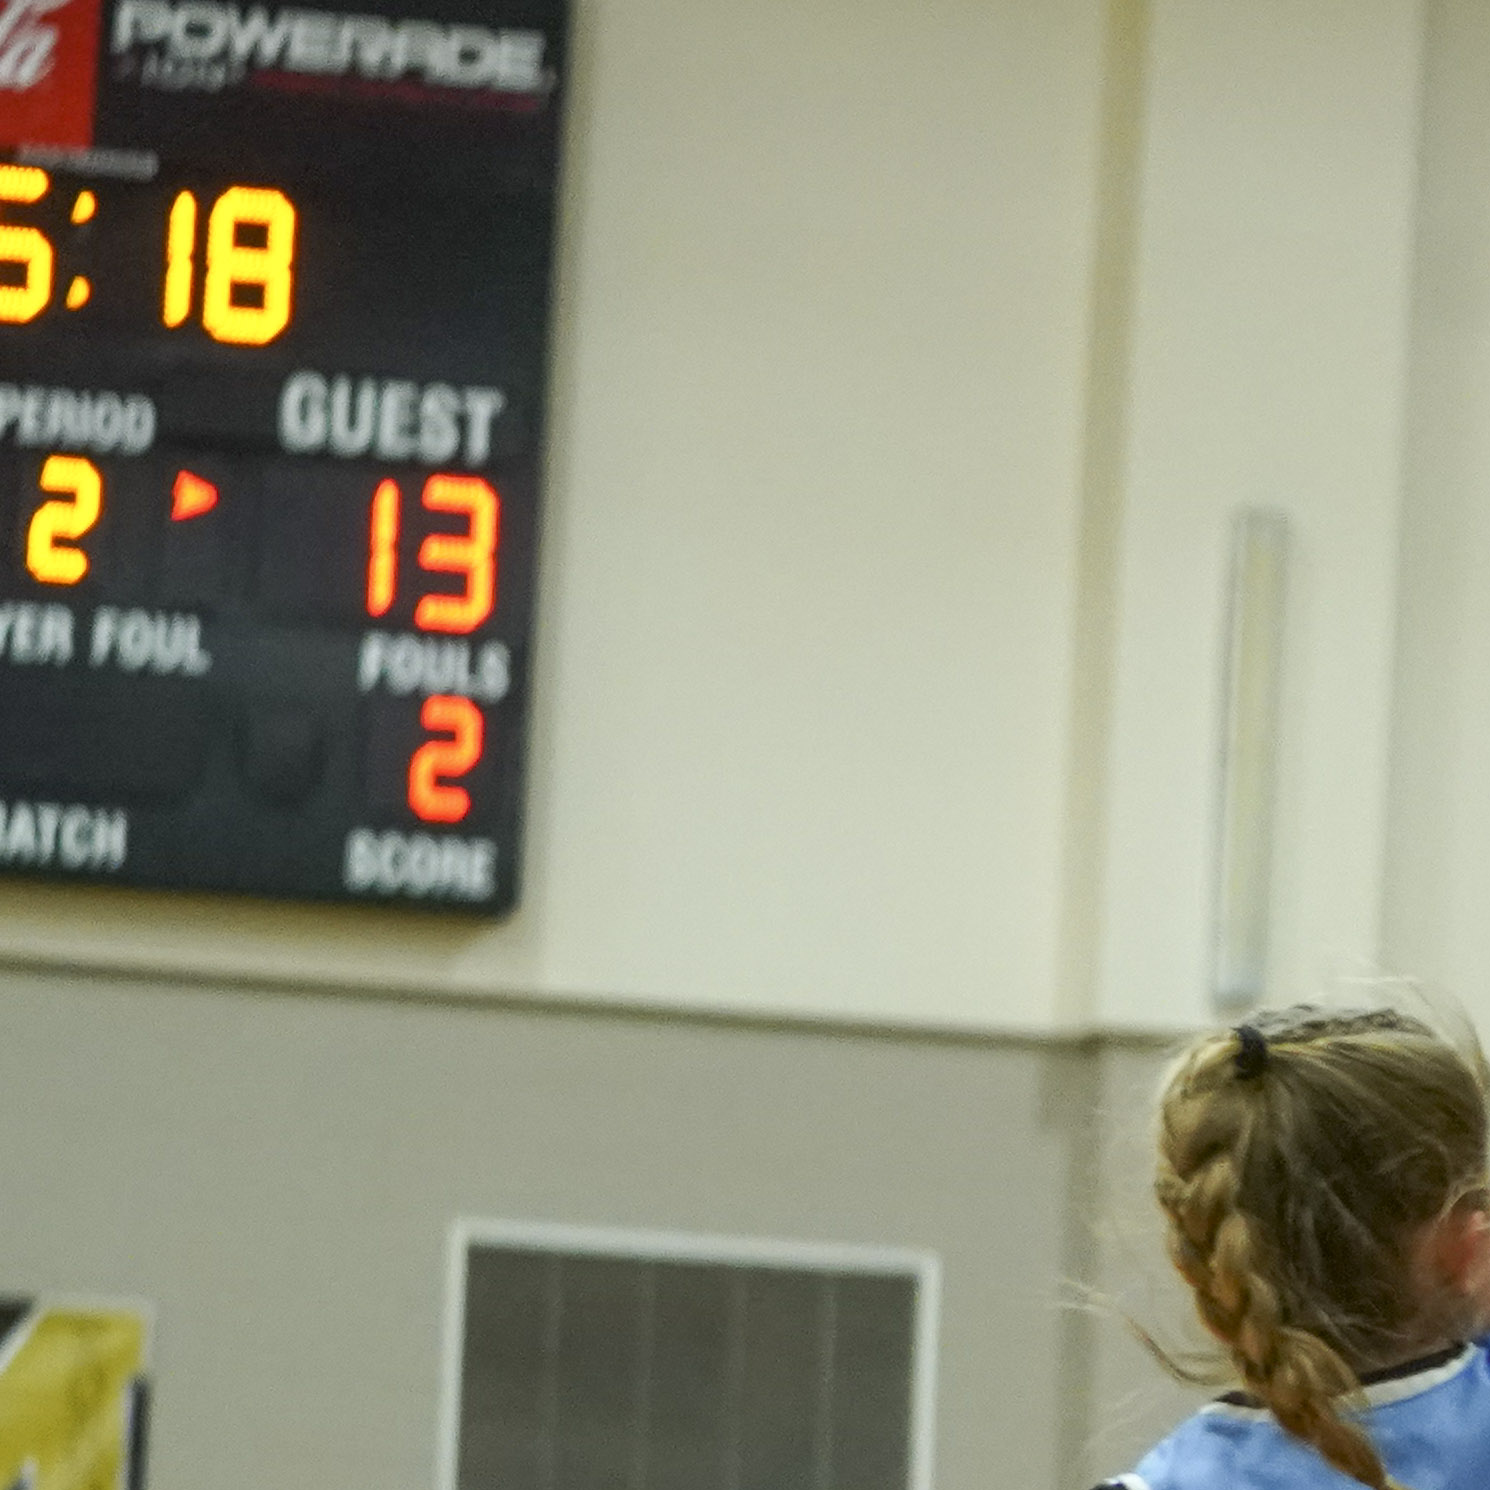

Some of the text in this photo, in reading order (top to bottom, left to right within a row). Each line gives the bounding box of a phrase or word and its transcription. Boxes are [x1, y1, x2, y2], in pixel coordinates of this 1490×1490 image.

[110, 0, 548, 93] POWERADE
[278, 370, 503, 466] GUEST
[27, 455, 101, 584] 2
[366, 473, 499, 634] 13
[91, 605, 212, 677] FOUL
[357, 631, 511, 702] FOULS
[407, 694, 484, 824] 2
[0, 803, 128, 871] ATCH
[343, 828, 498, 900] SCORE
